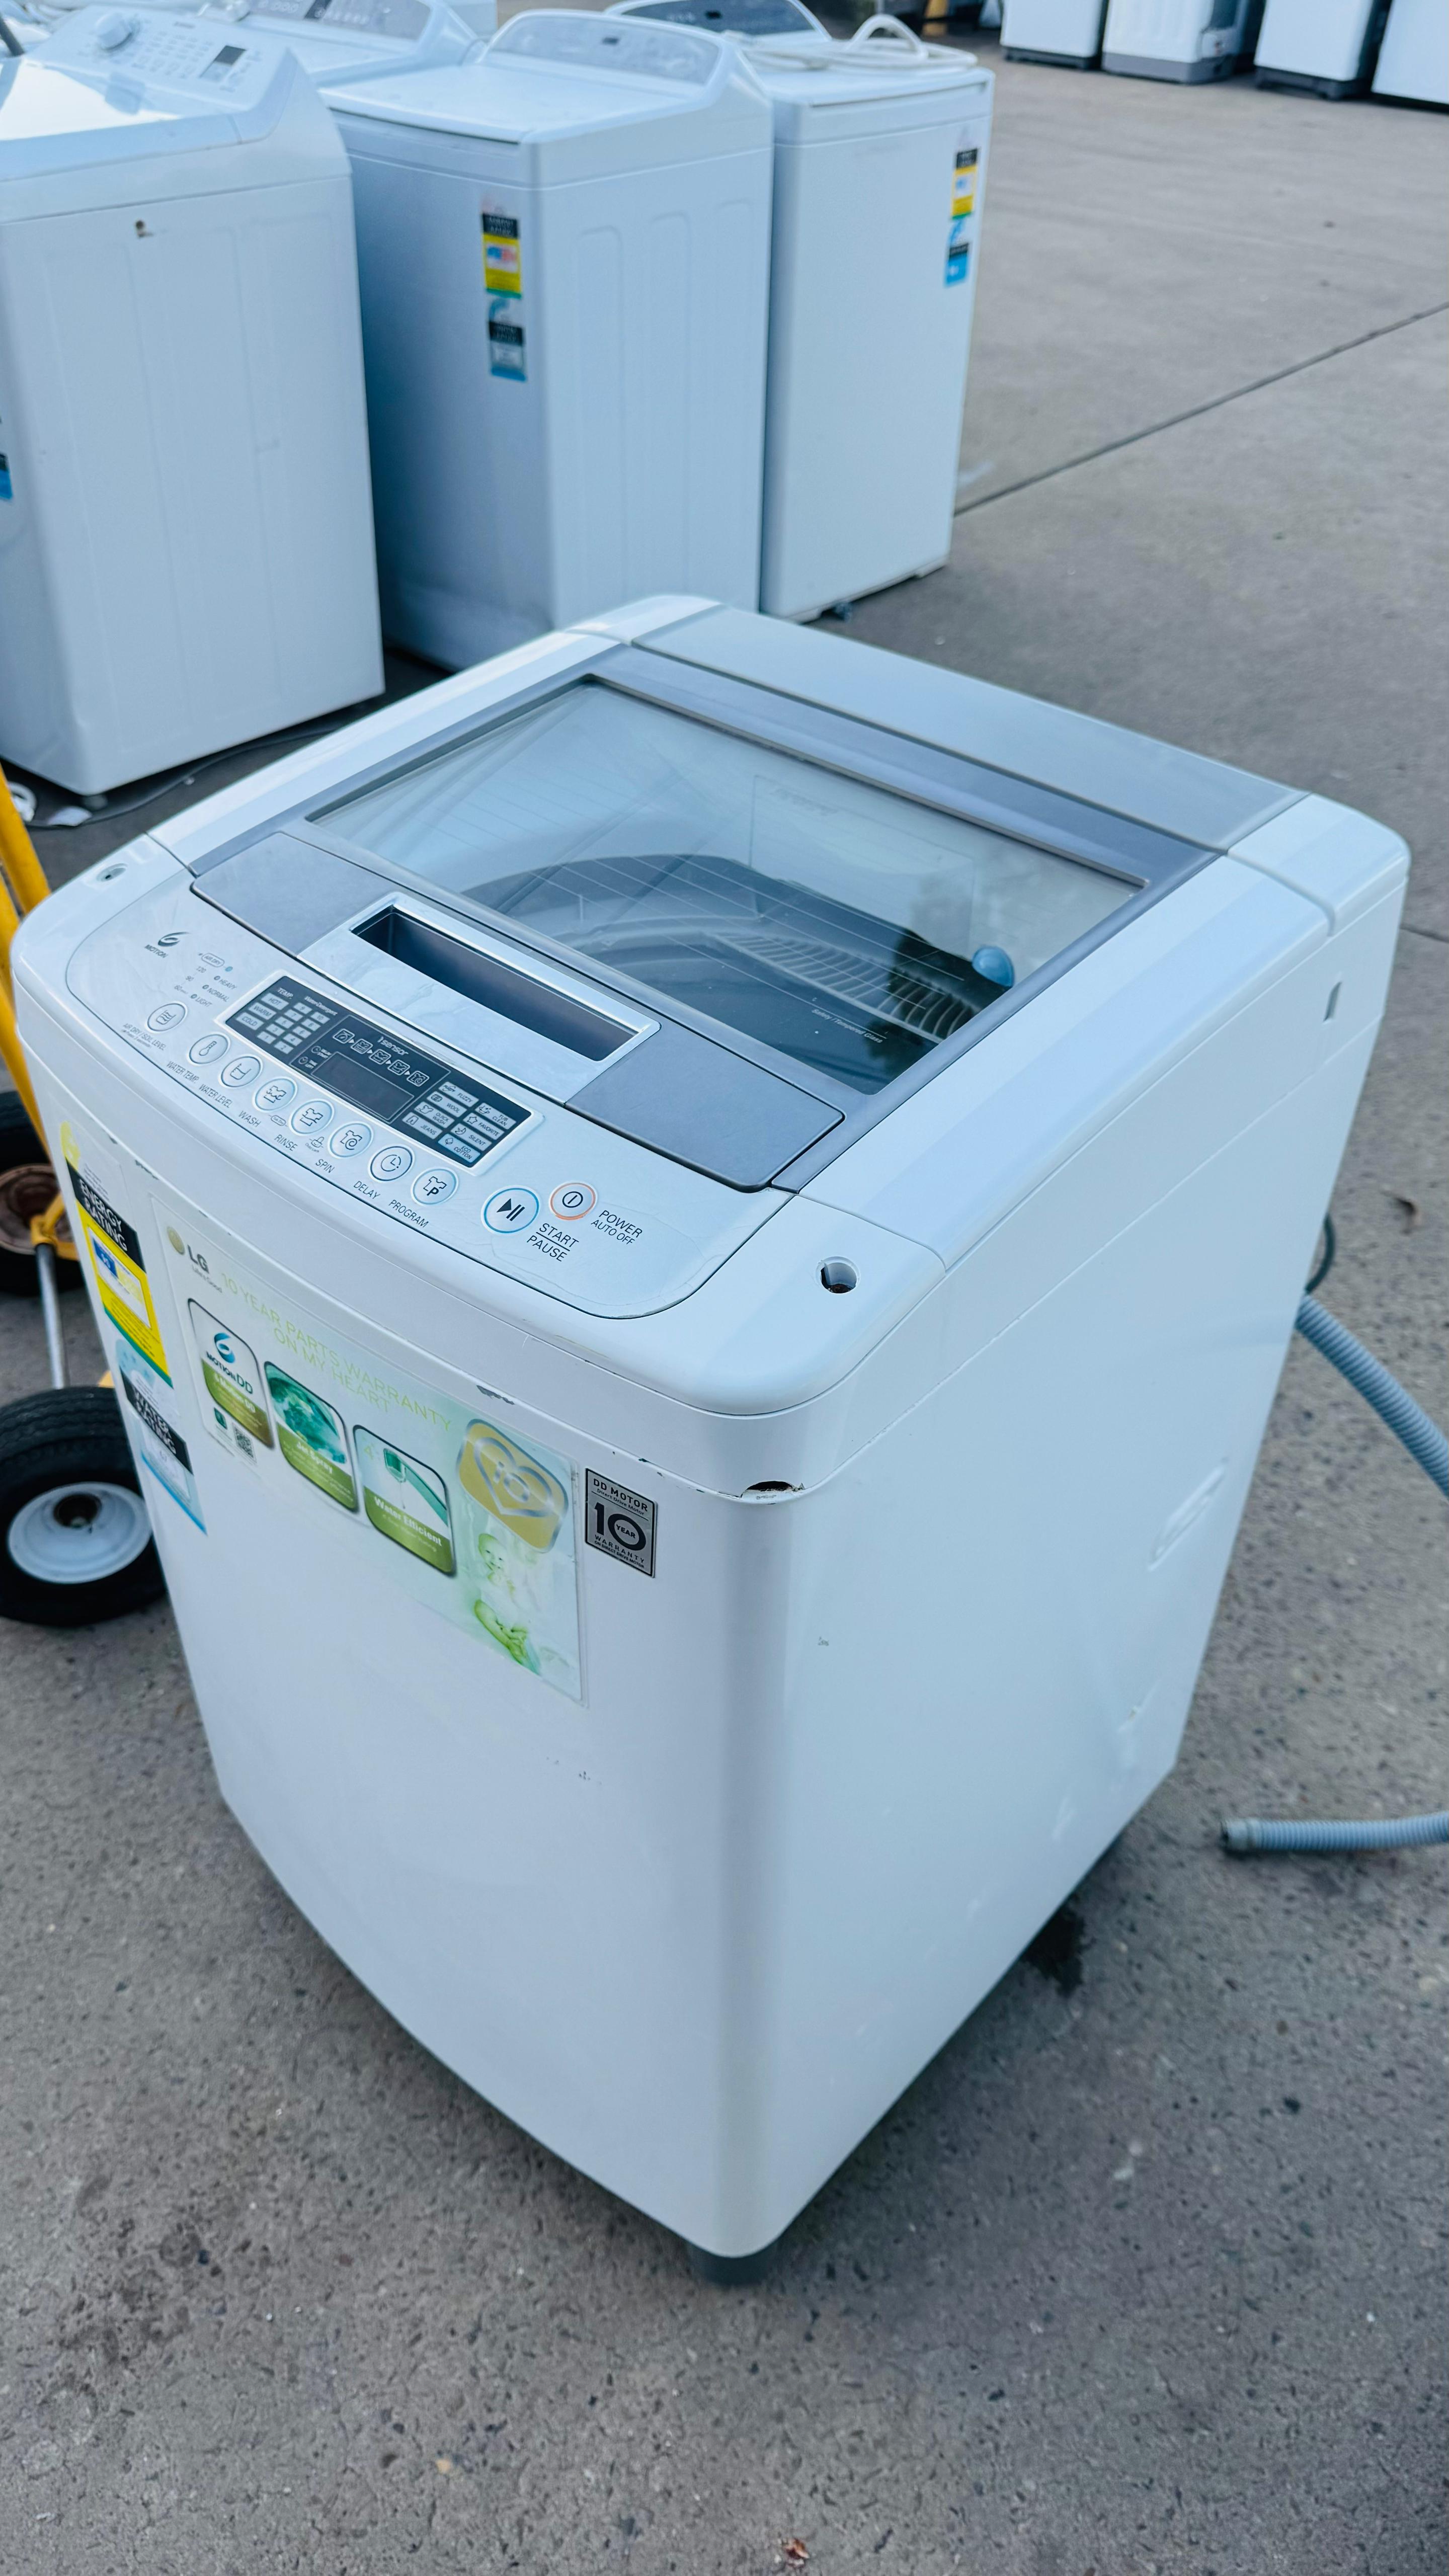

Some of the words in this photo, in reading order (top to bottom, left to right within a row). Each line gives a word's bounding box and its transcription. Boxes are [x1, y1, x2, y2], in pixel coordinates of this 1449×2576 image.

[144, 944, 169, 958] MOTION
[218, 979, 237, 990] HEAVY
[195, 997, 212, 1008] LIGHT
[207, 988, 230, 1002] NORMAL
[269, 996, 282, 1006] HOT
[253, 1005, 272, 1017] WARM
[242, 1014, 258, 1027] COLD
[812, 1009, 832, 1020] Safety
[835, 1018, 866, 1035] Tempered
[864, 1032, 883, 1043] Glass
[130, 1027, 141, 1035] DRY
[141, 1033, 152, 1043] SOIL
[151, 1039, 166, 1051] LEVEL
[167, 1061, 186, 1075] WATER
[199, 1084, 218, 1100] WATER
[215, 1094, 233, 1108] LEVEL
[457, 1093, 473, 1103] FUZZY
[436, 1112, 449, 1122] QUICK
[446, 1103, 460, 1113] WOOL
[238, 1110, 261, 1127] WASH
[432, 1116, 446, 1125] WASH
[492, 1116, 507, 1126] CLEAN
[420, 1124, 437, 1136] JEANS
[478, 1122, 500, 1137] FAVORITE
[274, 1134, 298, 1151] RINSE
[461, 1146, 471, 1154] ECO
[468, 1135, 486, 1147] SILENT
[454, 1147, 472, 1160] COTTON
[315, 1159, 335, 1173] SPIN
[353, 1180, 381, 1199] DELAY
[79, 1179, 122, 1232] ENERGY
[388, 1199, 429, 1228] PROGRAM
[84, 1197, 127, 1251] RATING
[591, 1220, 617, 1236] AUTO
[616, 1233, 635, 1245] OFF
[599, 1210, 642, 1238] POWER
[539, 1223, 579, 1248] START
[527, 1235, 568, 1262] PAUSE
[187, 1244, 209, 1274] LG
[221, 1273, 238, 1295] 10
[239, 1286, 282, 1328] YEAR
[286, 1320, 340, 1367] PARTS
[344, 1357, 451, 1432] WARRANTY
[274, 1328, 298, 1354] ON
[302, 1347, 326, 1371] MY
[331, 1367, 389, 1413] HEART
[133, 1387, 172, 1439] WATER
[136, 1401, 177, 1455] RATING
[594, 1478, 607, 1491] DD
[611, 1487, 648, 1512] MOTOR
[597, 1488, 612, 1499] Direct
[613, 1497, 627, 1506] Drive
[628, 1504, 644, 1515] Motor
[374, 1496, 401, 1520] Water
[403, 1514, 442, 1547] Efficient
[594, 1502, 647, 1551] 10
[616, 1523, 636, 1539] YEAR
[595, 1534, 645, 1563] WARRANTY
[601, 1544, 616, 1554] DIRECT
[616, 1551, 628, 1561] DRIVE
[629, 1558, 645, 1568] MOTOR
